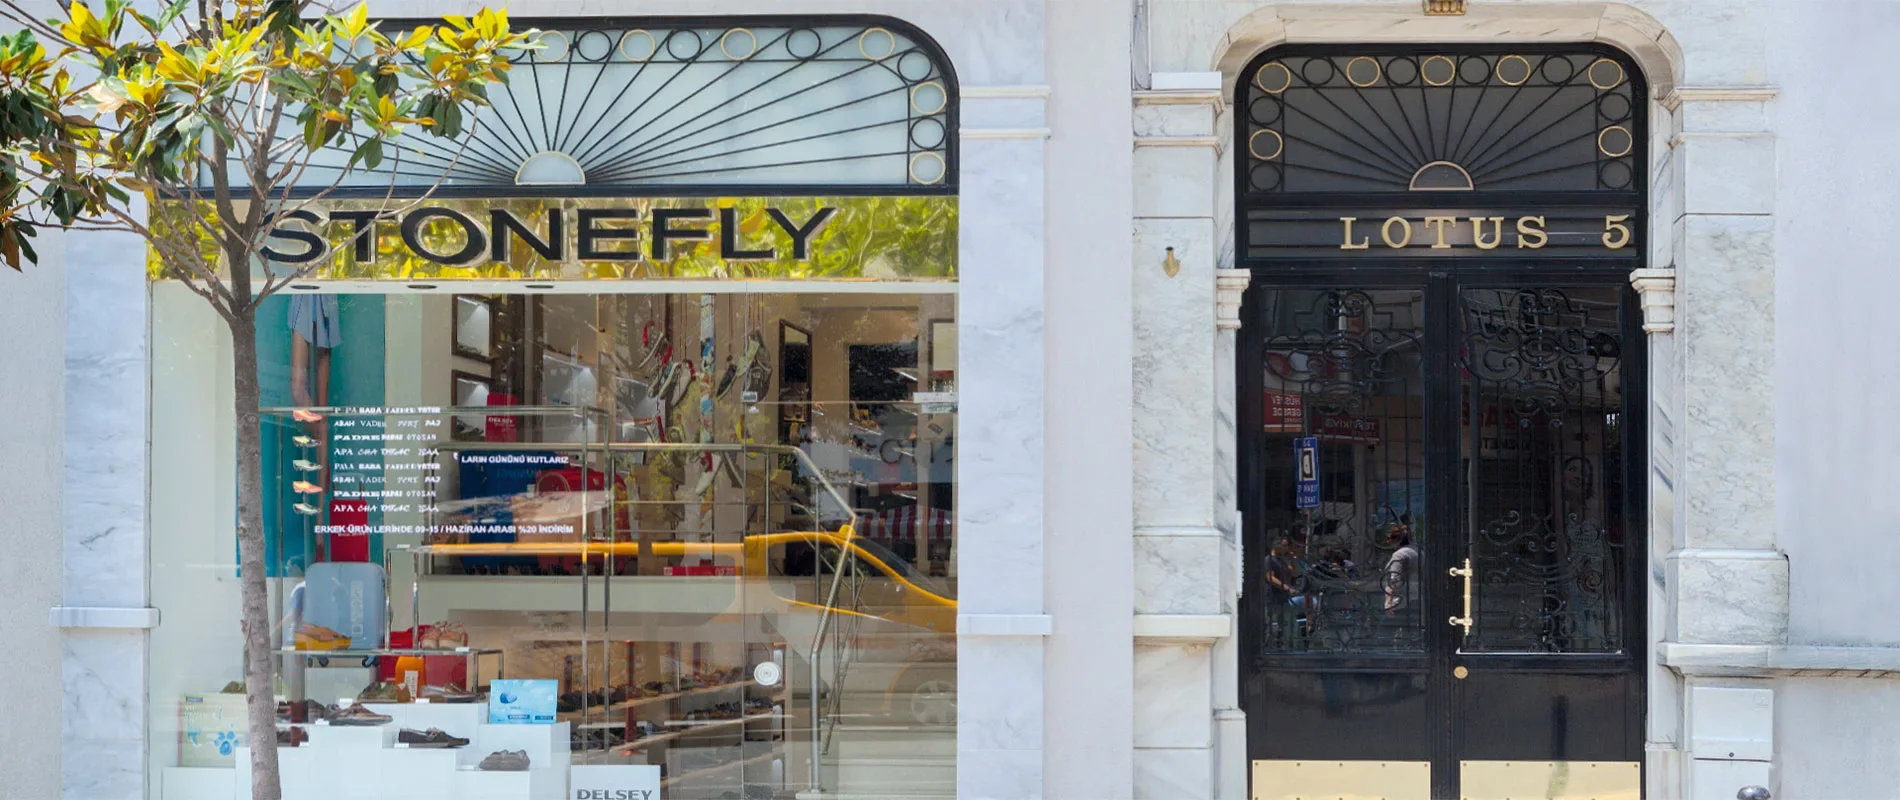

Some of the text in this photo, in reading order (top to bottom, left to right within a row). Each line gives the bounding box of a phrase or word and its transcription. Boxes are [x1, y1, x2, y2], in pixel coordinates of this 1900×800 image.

[260, 205, 839, 266] STONEFLY
[1339, 213, 1631, 250] LOTUS 5
[526, 455, 569, 463] KUTLARIZ
[314, 525, 346, 533] ERKEK
[445, 524, 486, 533] HAZİRAN
[538, 523, 574, 533] İNDİRİM
[576, 788, 653, 800] DELSEY
